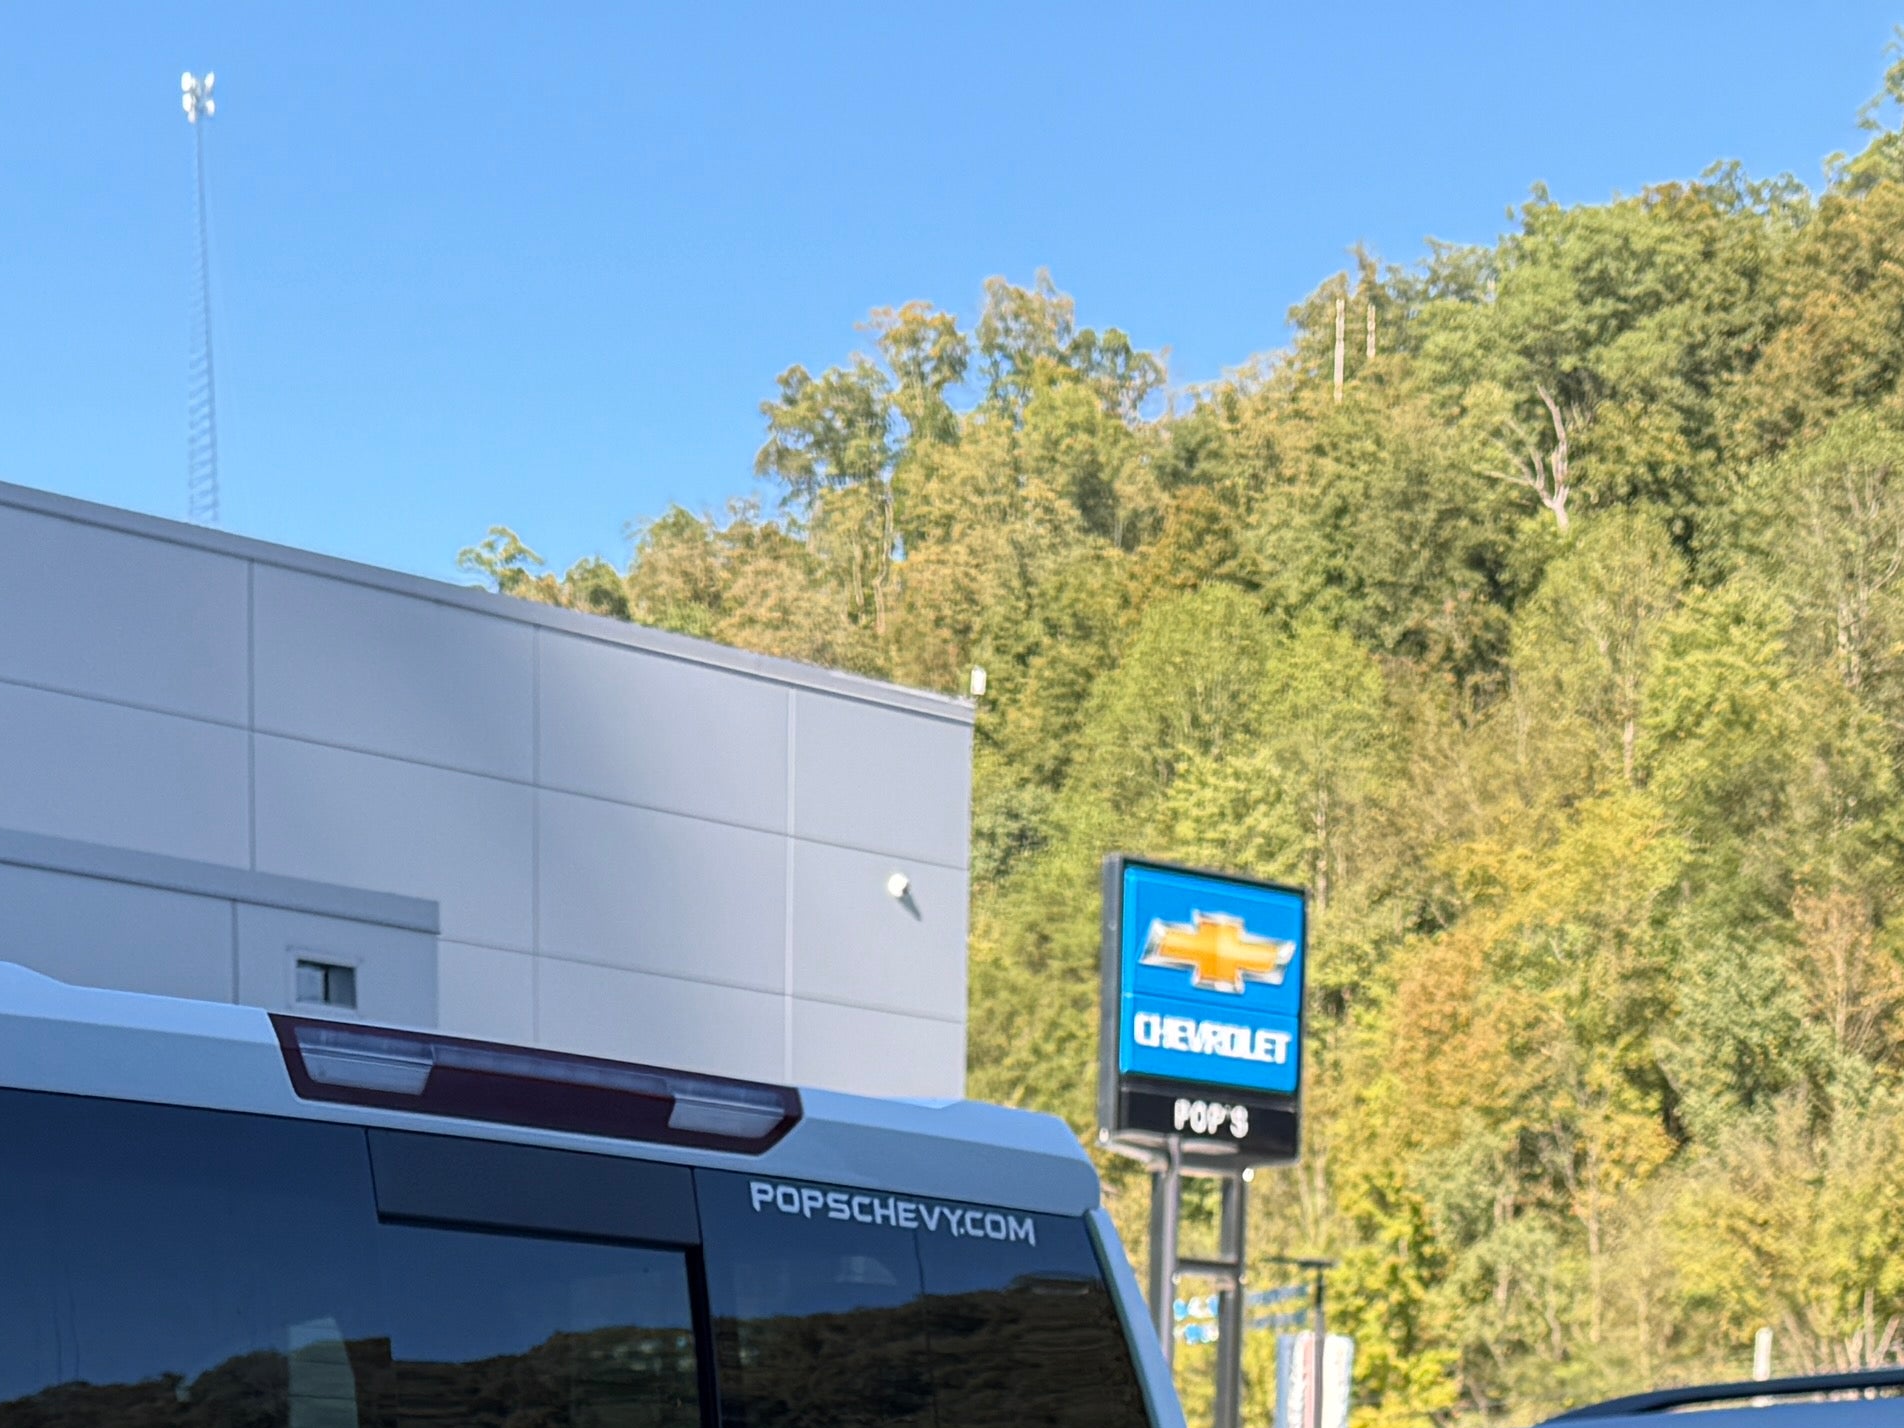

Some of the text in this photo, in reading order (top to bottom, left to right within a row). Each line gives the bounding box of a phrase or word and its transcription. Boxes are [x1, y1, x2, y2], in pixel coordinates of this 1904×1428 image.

[1134, 1011, 1292, 1065] CHEVROLET
[1173, 1098, 1250, 1139] POP'S
[749, 1181, 1037, 1247] POPSCHEVY.COM
